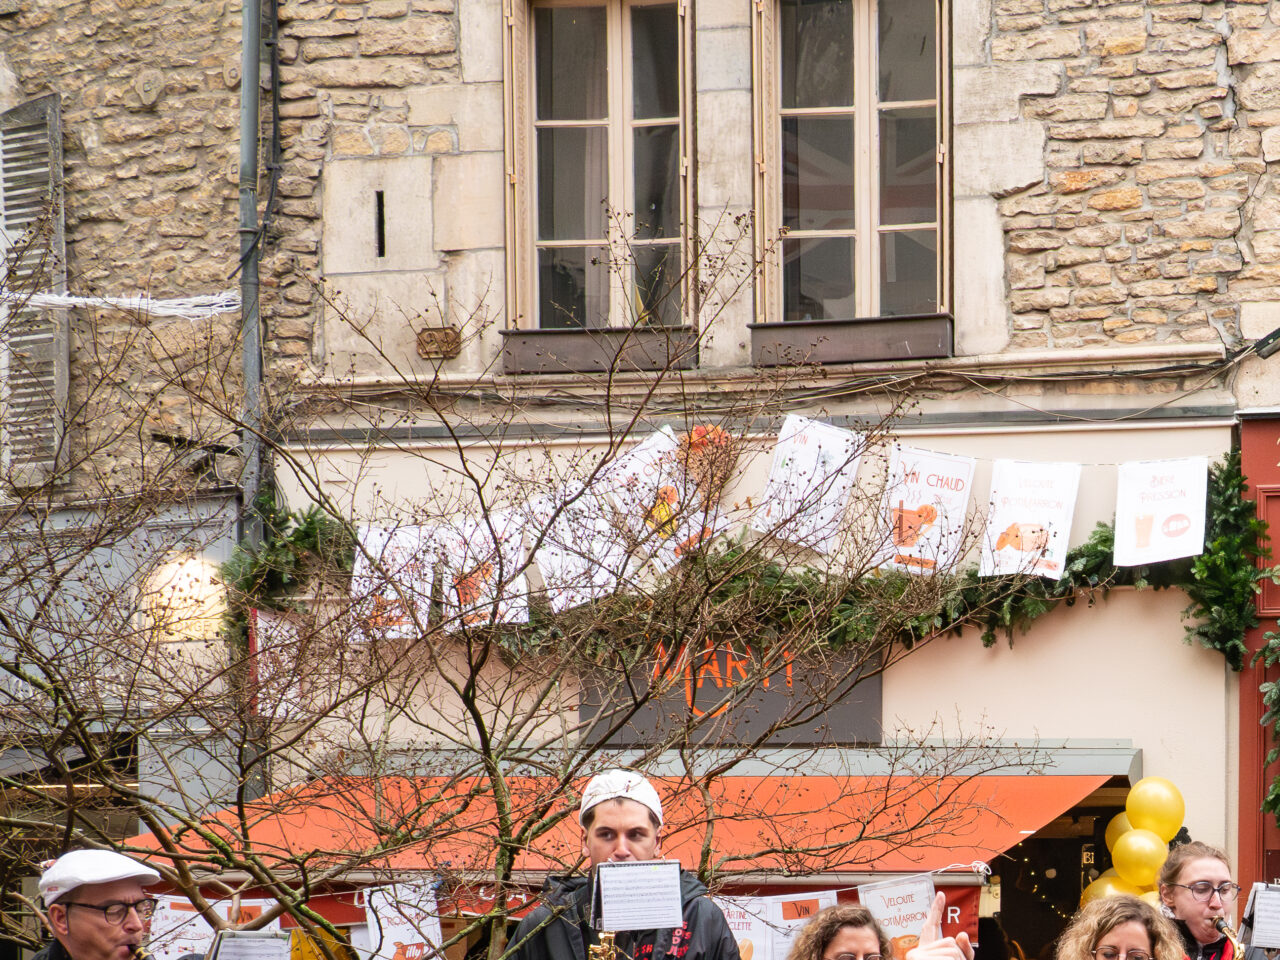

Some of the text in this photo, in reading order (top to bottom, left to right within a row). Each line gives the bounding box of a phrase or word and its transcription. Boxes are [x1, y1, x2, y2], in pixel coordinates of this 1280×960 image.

[901, 460, 965, 492] VIN CHAUD
[792, 903, 810, 917] VIN
[405, 946, 422, 959] illy
